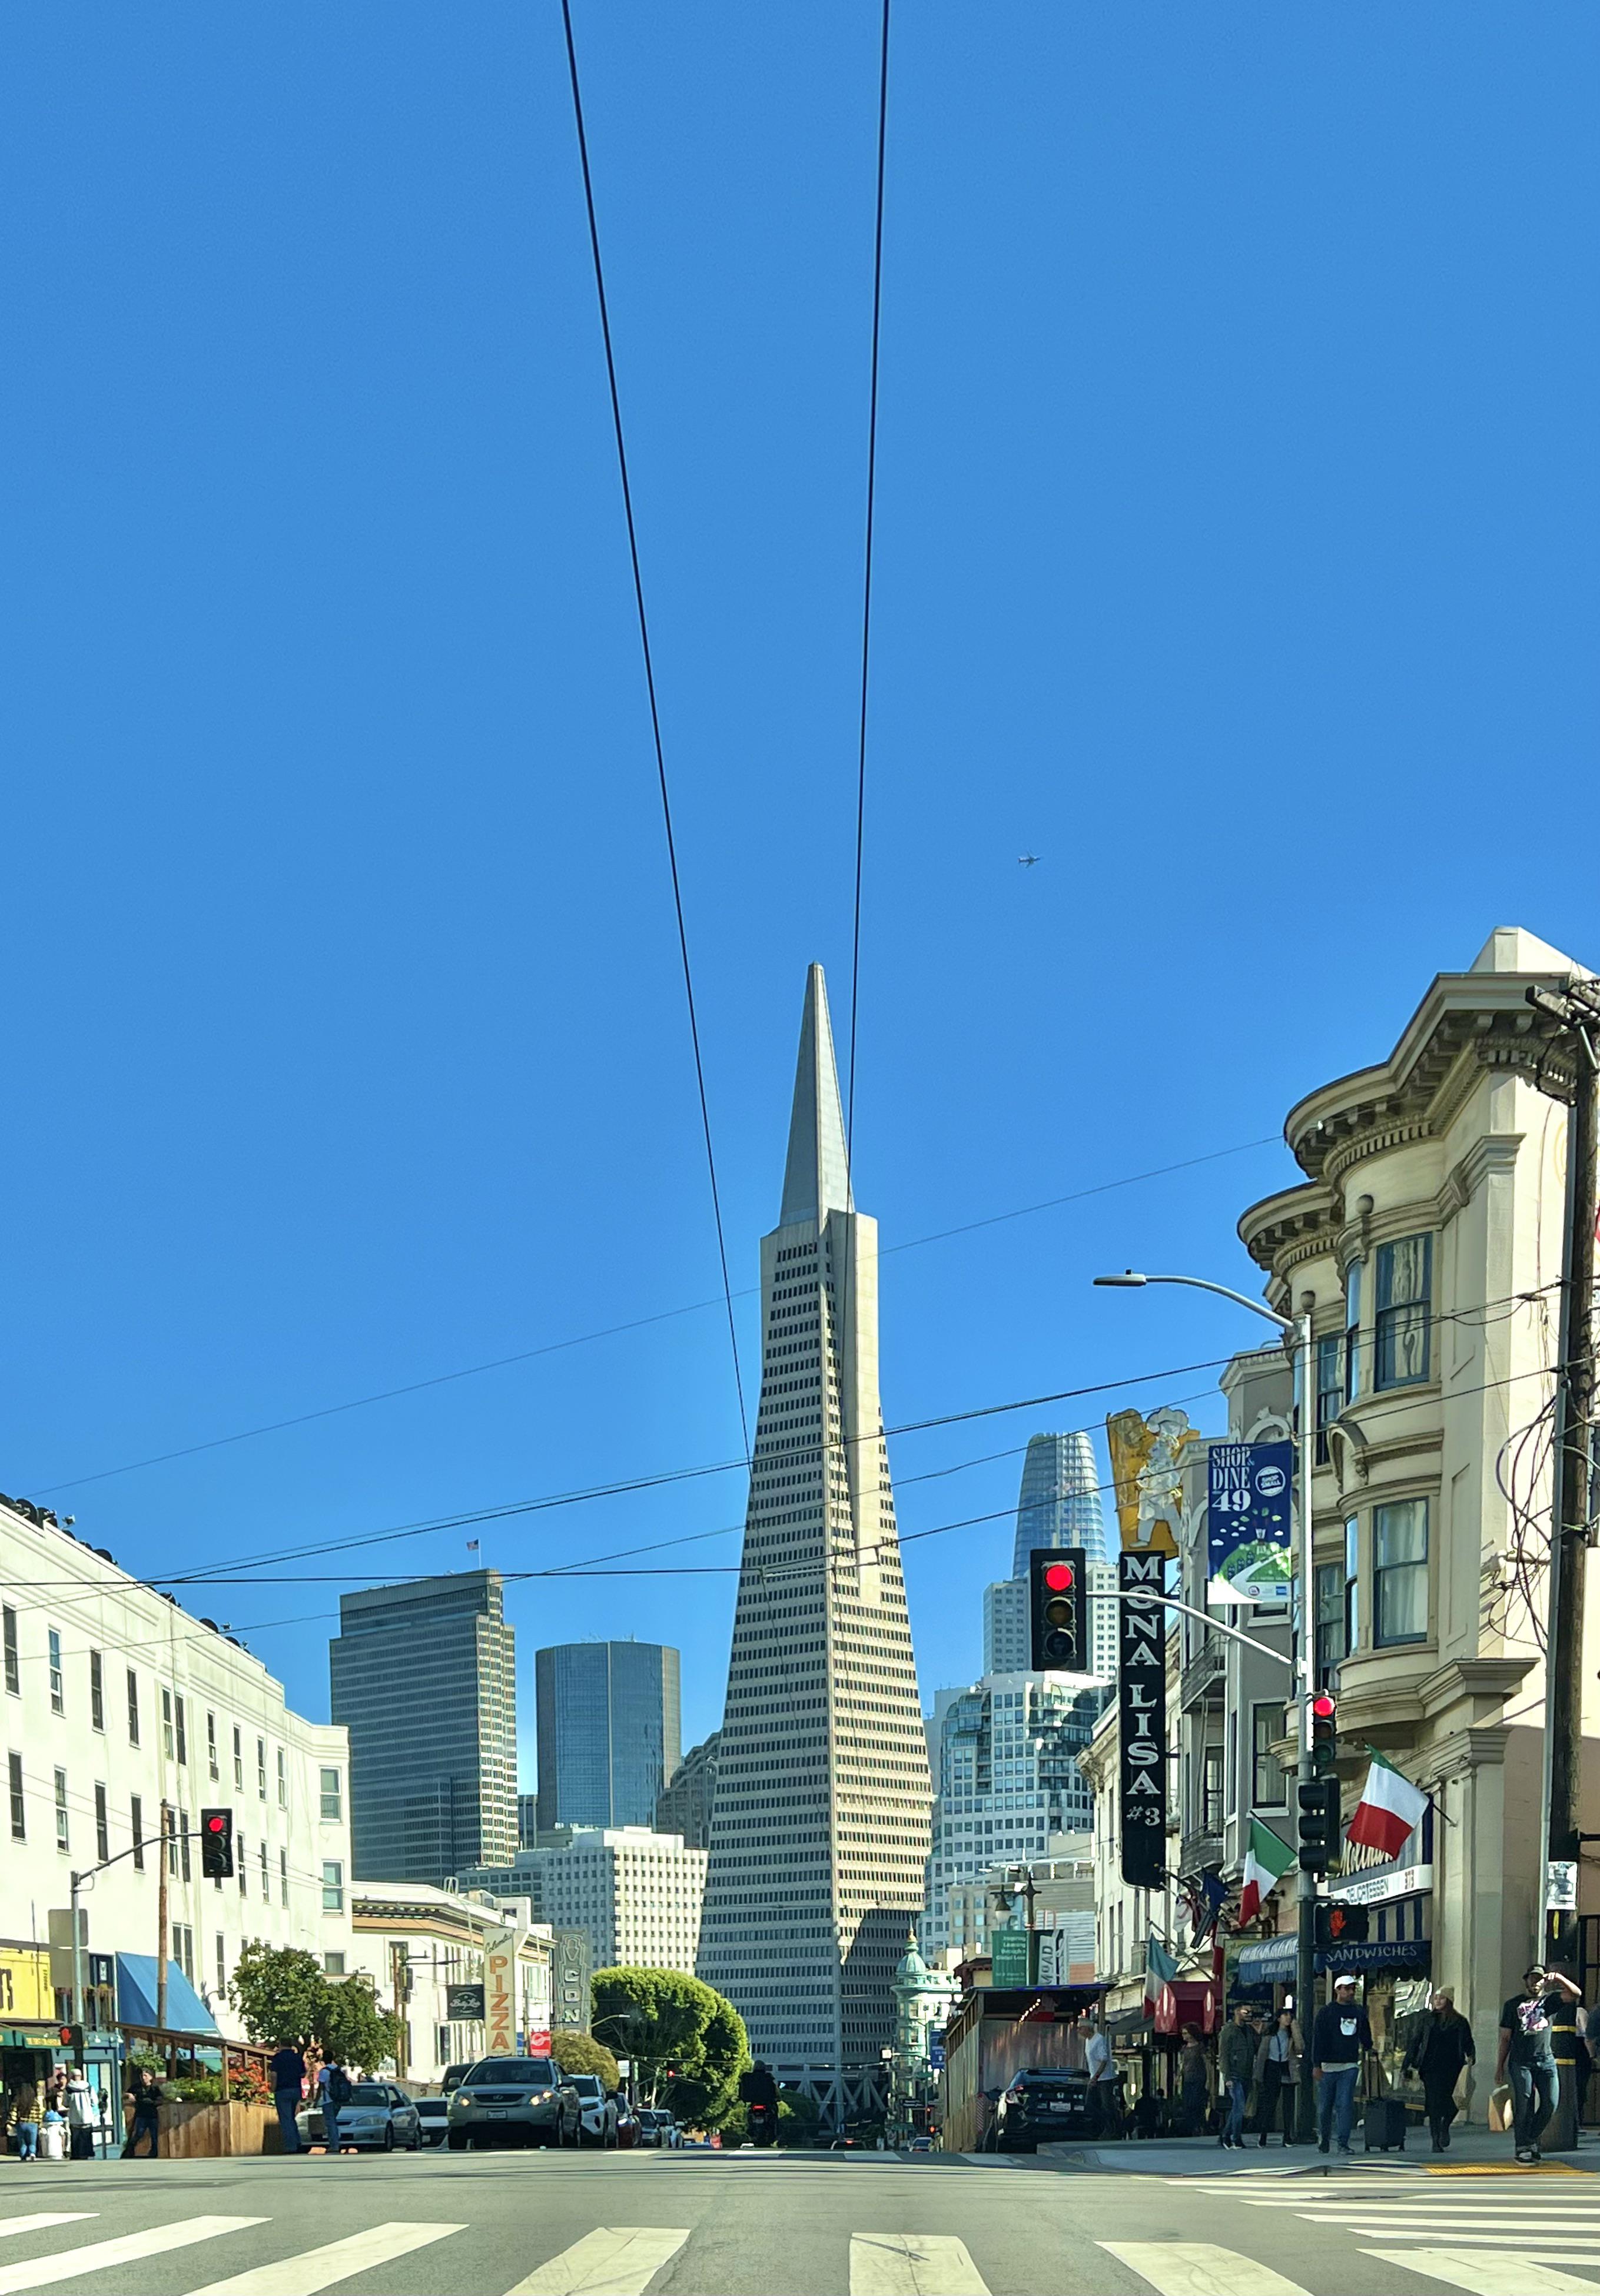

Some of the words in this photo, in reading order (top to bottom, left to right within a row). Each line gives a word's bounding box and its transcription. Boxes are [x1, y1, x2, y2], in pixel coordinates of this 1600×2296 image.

[1212, 1447, 1251, 1467] SHOP
[1213, 1467, 1250, 1489] DINE
[1211, 1489, 1251, 1511] 49
[1123, 1556, 1162, 1666] MONA
[1126, 1684, 1161, 1795] LISA
[1126, 1806, 1161, 1826] #3
[1335, 1836, 1395, 1877] Molina
[1326, 1945, 1418, 1963] SANDWICHES
[489, 1956, 510, 2049] PIZZA
[563, 1968, 581, 2035] CON
